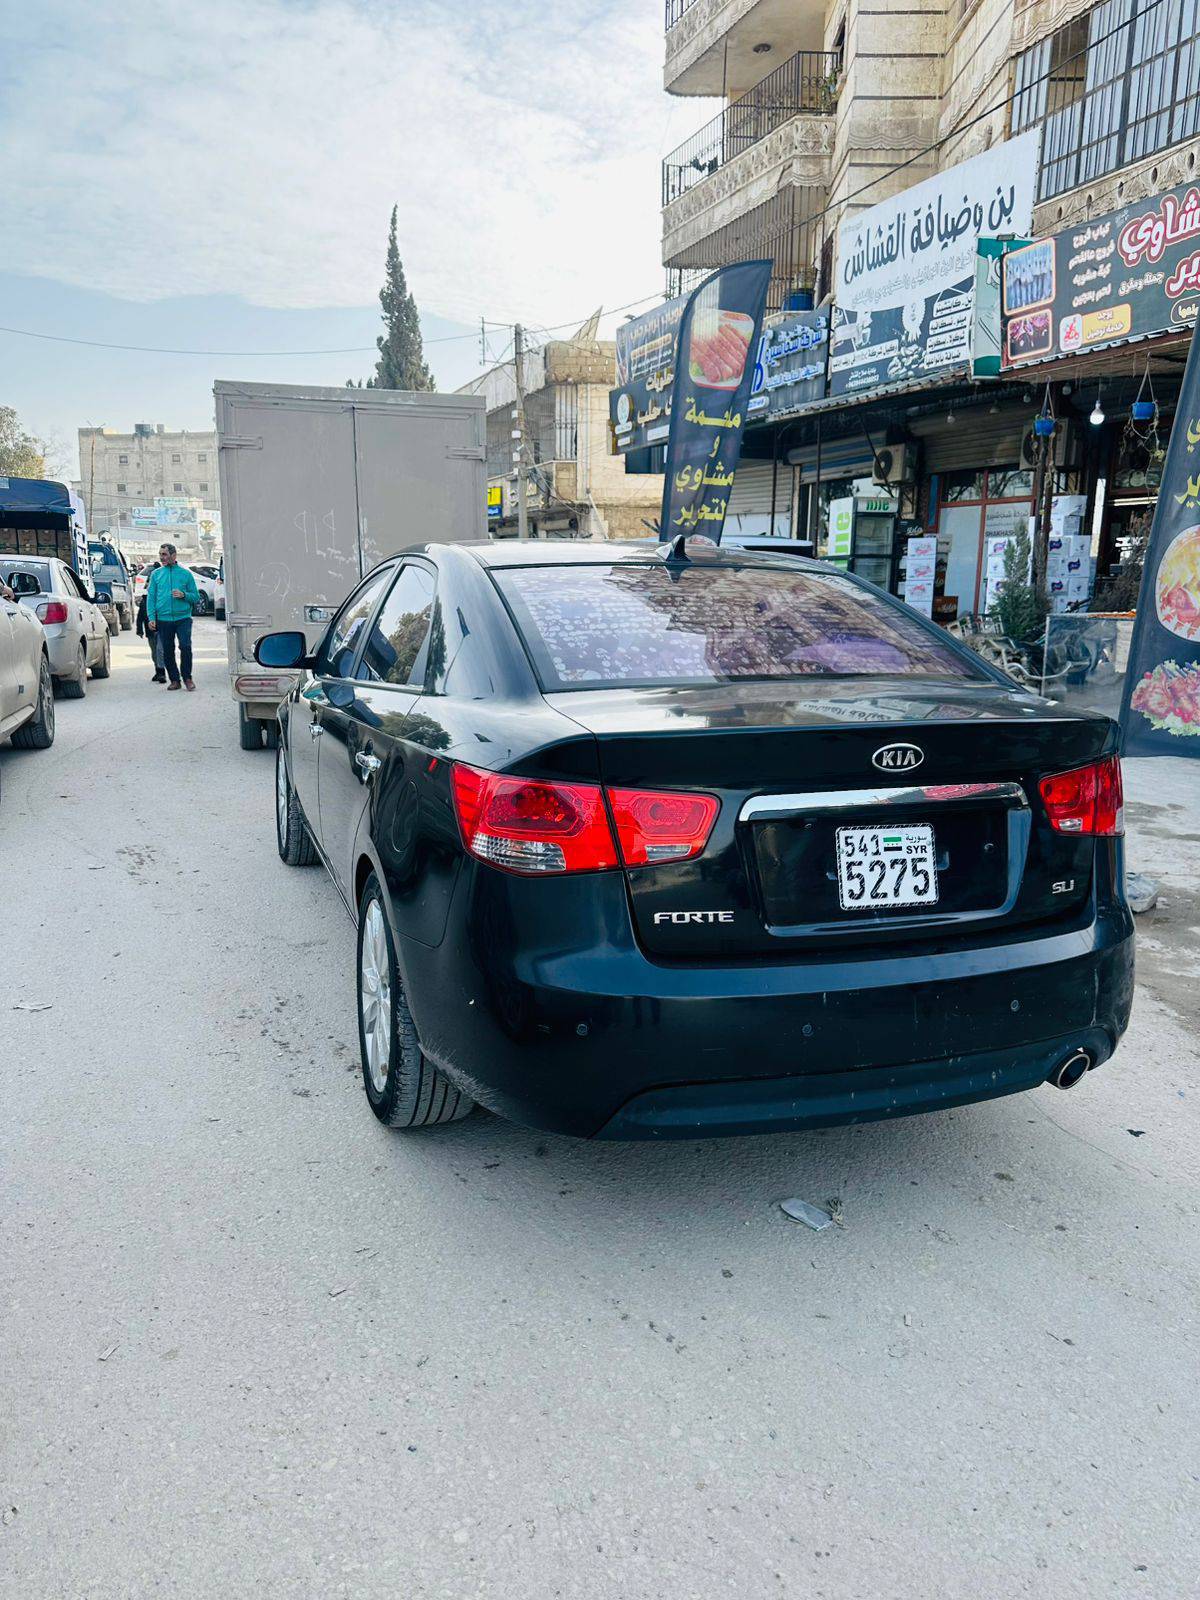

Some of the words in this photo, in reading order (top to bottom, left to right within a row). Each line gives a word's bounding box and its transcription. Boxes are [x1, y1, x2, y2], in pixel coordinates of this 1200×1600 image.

[987, 184, 1016, 232] بن
[910, 194, 984, 254] وضيافة
[1117, 187, 1200, 266] شاوي
[844, 211, 907, 285] القشاش
[708, 435, 720, 458] و
[675, 461, 735, 493] مشاوي
[882, 750, 916, 767] KIA
[844, 834, 882, 857] 541
[905, 833, 928, 844] سورية
[906, 845, 928, 855] SYR
[845, 857, 930, 901] 5275
[653, 910, 735, 924] FORTE
